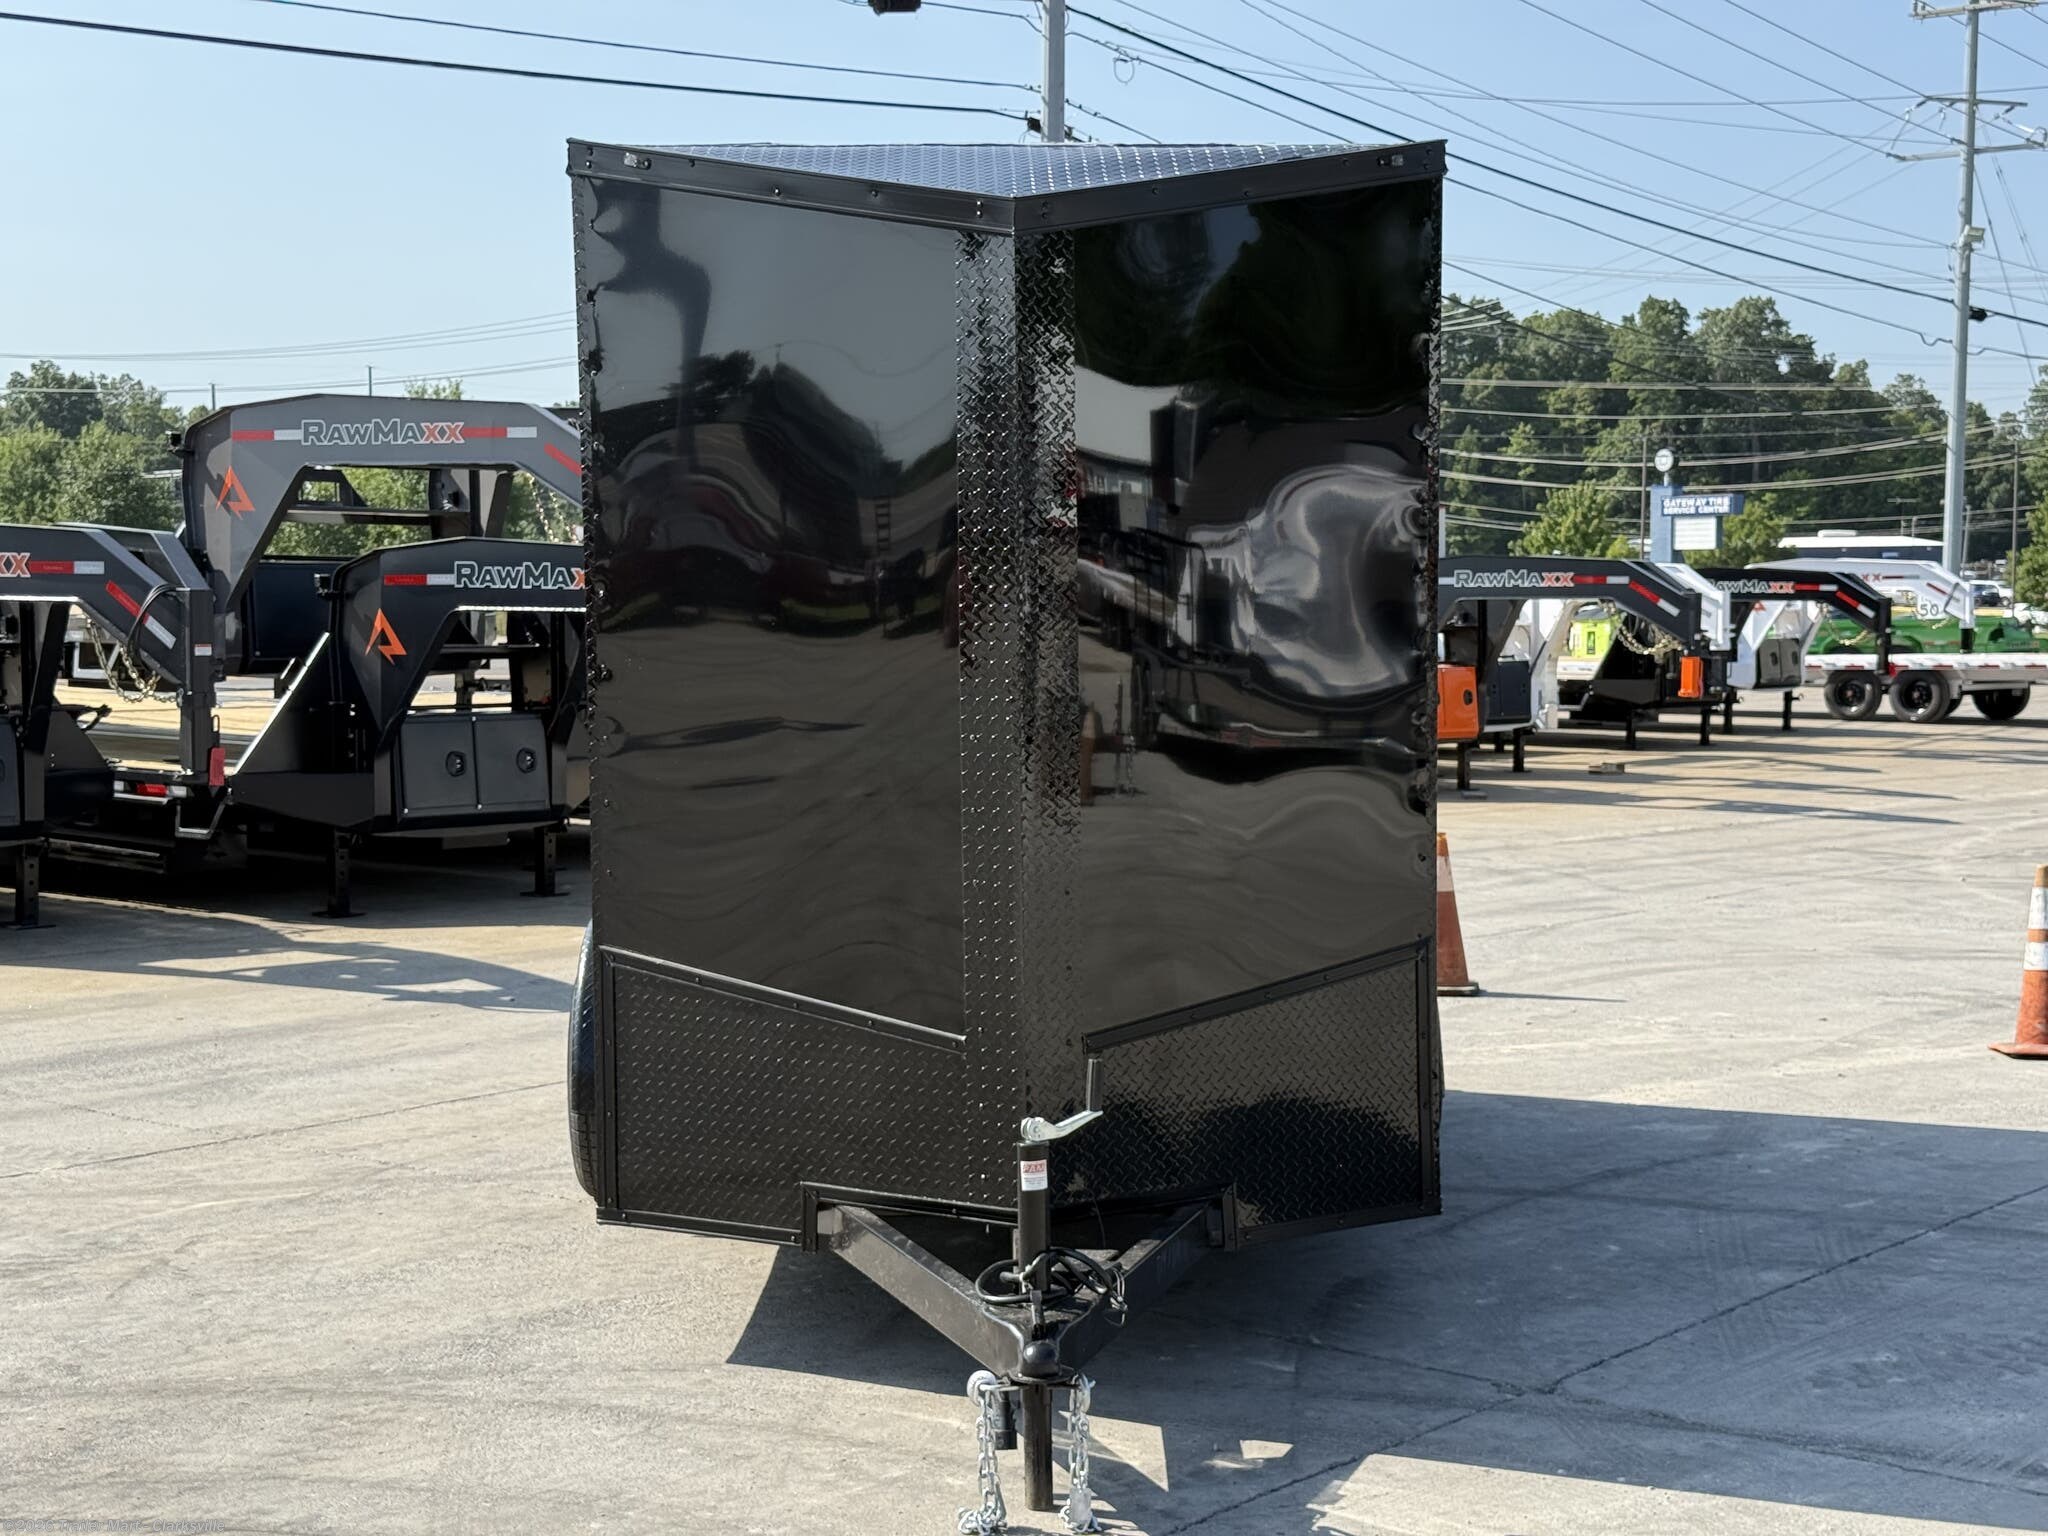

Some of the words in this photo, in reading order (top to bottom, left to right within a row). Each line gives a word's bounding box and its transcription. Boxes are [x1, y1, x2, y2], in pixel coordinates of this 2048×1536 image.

[1663, 498, 1706, 508] GATEWAY
[1708, 496, 1730, 506] TIRE
[1697, 506, 1730, 514] CENTER
[1920, 603, 1939, 617] 50
